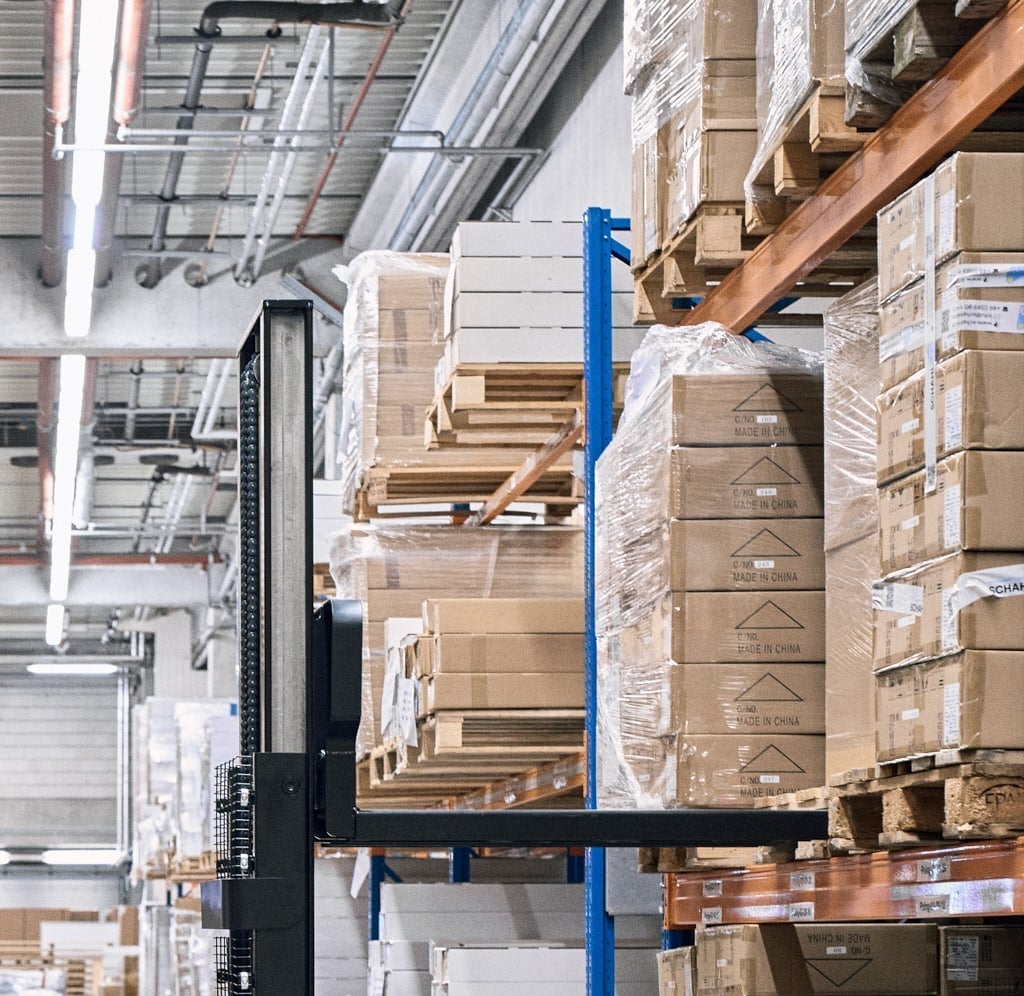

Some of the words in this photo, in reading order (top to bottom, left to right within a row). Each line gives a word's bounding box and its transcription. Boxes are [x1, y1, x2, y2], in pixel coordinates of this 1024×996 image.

[735, 427, 759, 437] MADE
[761, 427, 771, 437] IN
[760, 500, 769, 510] IN
[771, 499, 798, 510] CHINA
[733, 572, 757, 582] MADE
[760, 572, 769, 582] IN
[771, 572, 798, 582] CHINA
[764, 644, 773, 654] IN
[775, 643, 801, 654] CHINA
[763, 716, 772, 726] IN
[774, 716, 800, 726] CHINA
[740, 788, 764, 798] MADE
[808, 933, 833, 943] CHINA
[836, 934, 845, 944] IN
[847, 933, 871, 944] MADE
